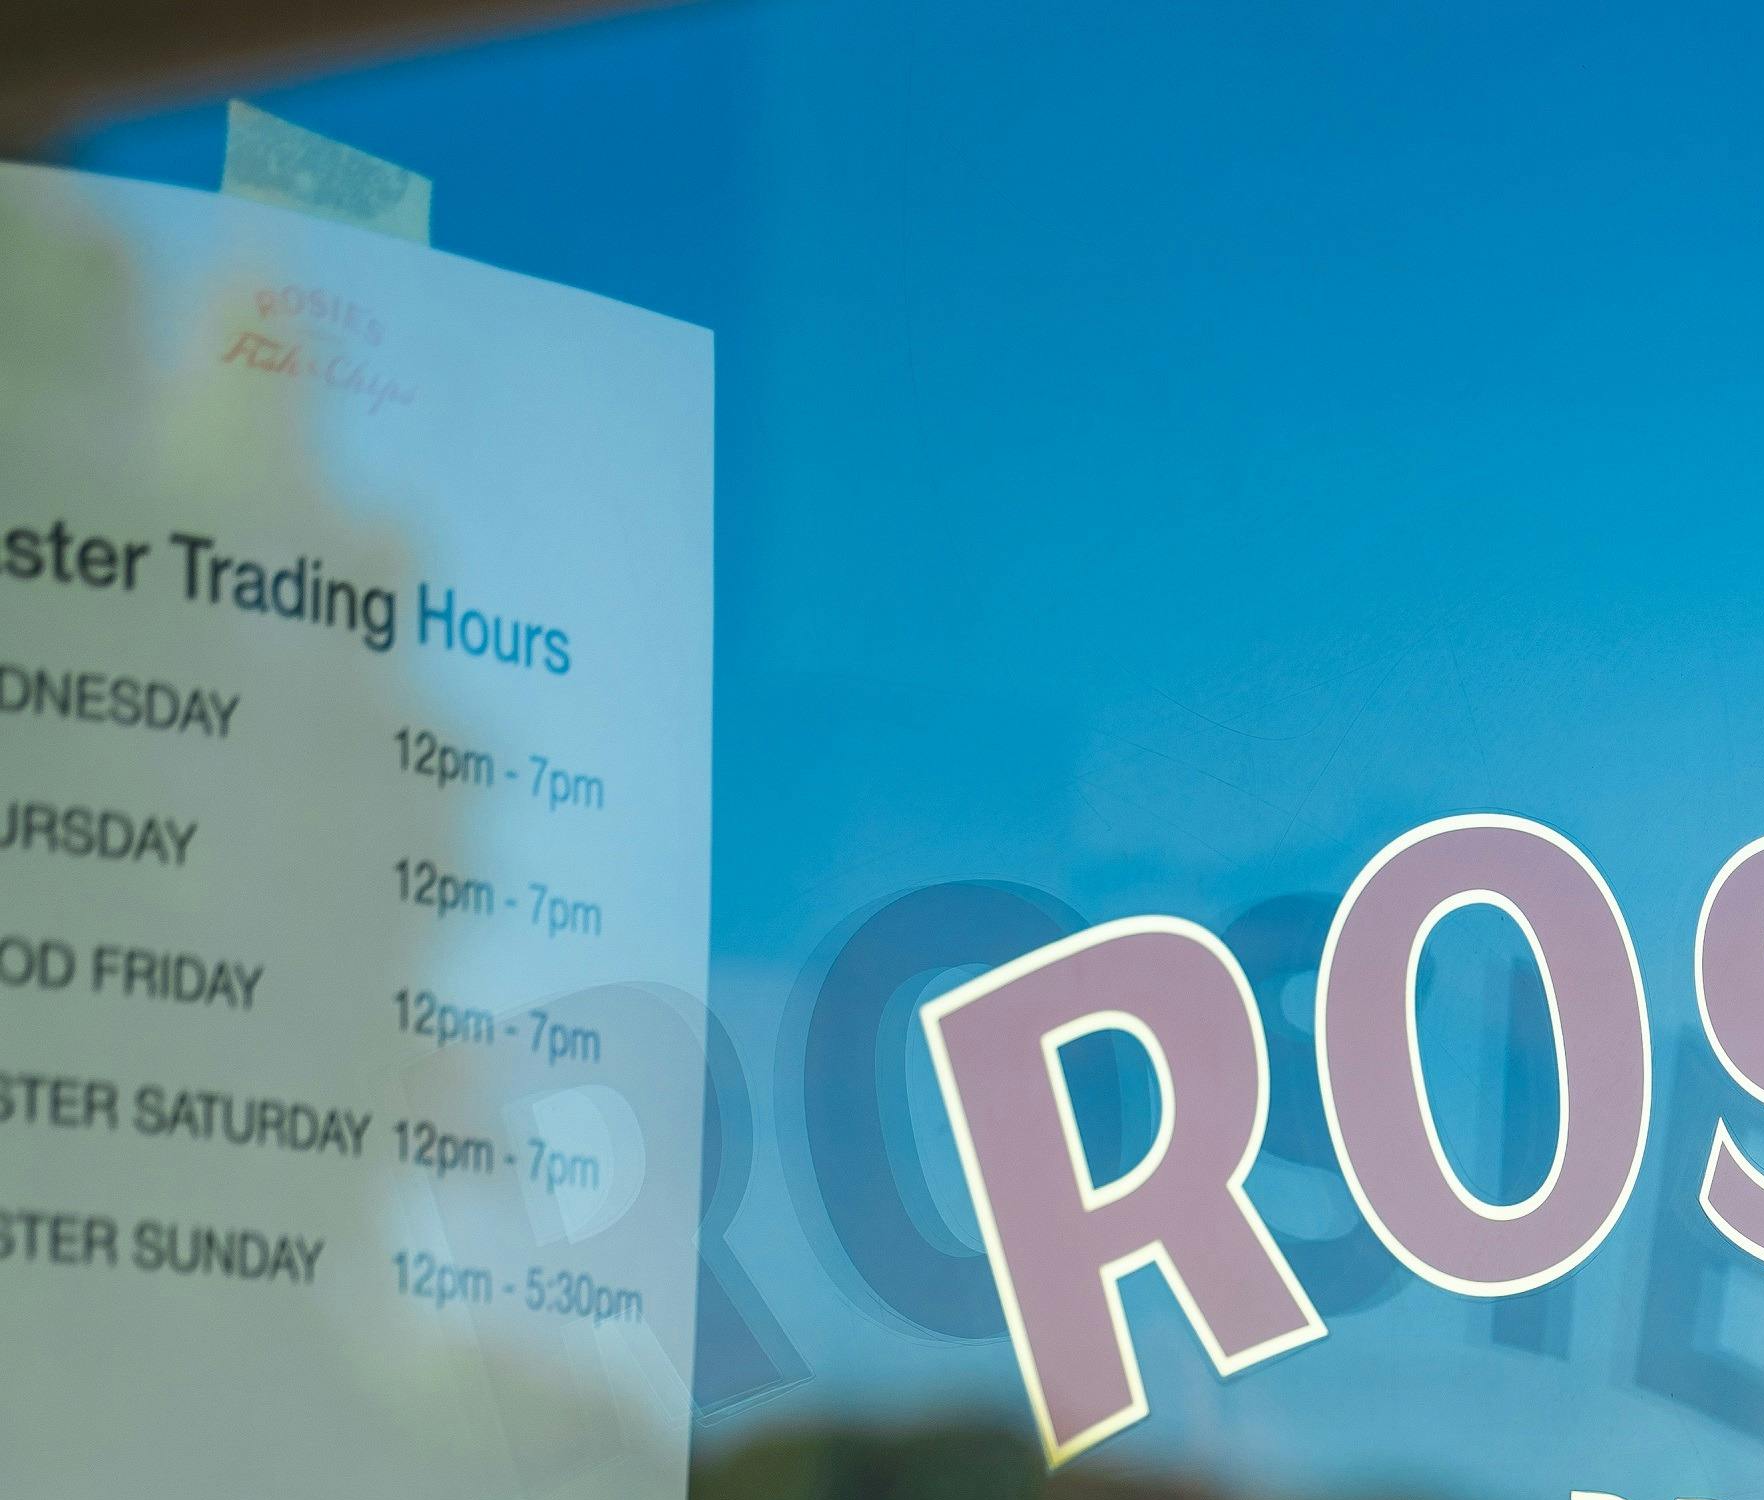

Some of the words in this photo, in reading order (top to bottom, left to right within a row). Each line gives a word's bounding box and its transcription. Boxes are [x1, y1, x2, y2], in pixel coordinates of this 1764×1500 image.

[0, 518, 151, 592] ster
[168, 530, 397, 654] Trading
[417, 581, 572, 677] Hours
[392, 725, 495, 789] 12pm
[528, 752, 605, 812] 7pm
[392, 857, 495, 920] 12pm
[528, 881, 603, 939] 7pm
[0, 934, 77, 991] OD
[91, 944, 265, 1011] FRIDAY
[392, 987, 495, 1049] 12pm
[527, 1007, 602, 1067] 7pm
[132, 1083, 373, 1158] SATURDAY
[391, 1118, 495, 1180] 12pm
[527, 1136, 601, 1195] 7pm
[131, 1218, 325, 1285] SUNDAY
[390, 1248, 493, 1311] 12pm
[525, 1265, 645, 1328] 5:30pm
